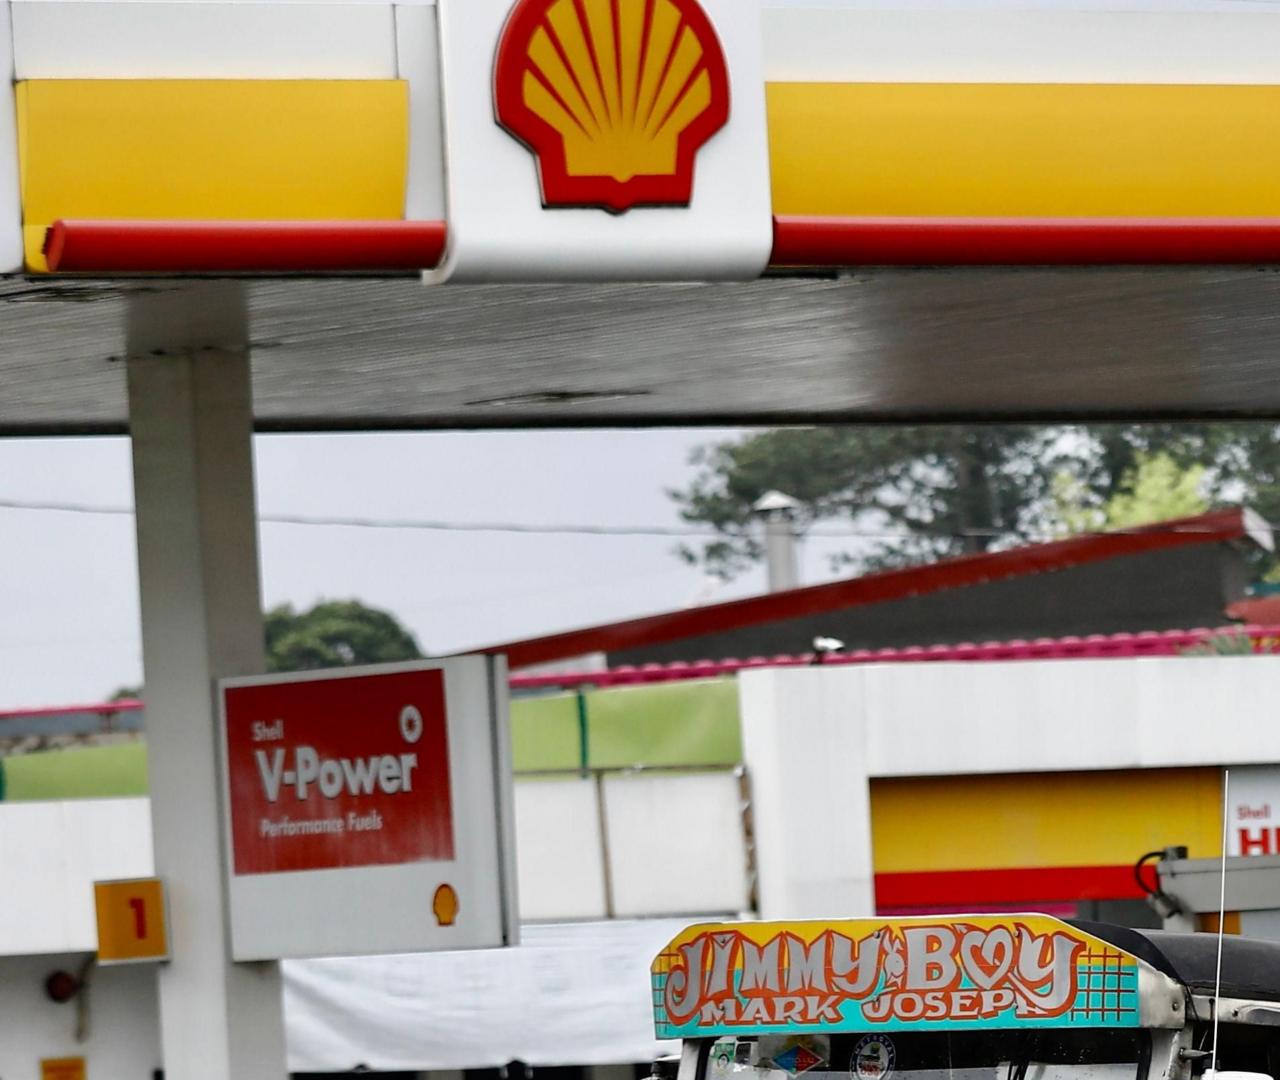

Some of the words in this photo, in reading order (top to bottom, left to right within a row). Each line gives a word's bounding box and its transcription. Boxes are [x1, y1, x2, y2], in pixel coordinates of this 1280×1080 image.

[253, 719, 285, 742] Shell
[256, 745, 418, 803] V-Power
[261, 815, 344, 838] Performance
[348, 809, 382, 831] Fuels
[1236, 803, 1271, 820] Shell
[129, 898, 146, 940] 1
[664, 928, 889, 1020] JIMMY
[900, 924, 1087, 1012] BOY
[700, 995, 840, 1022] MARK
